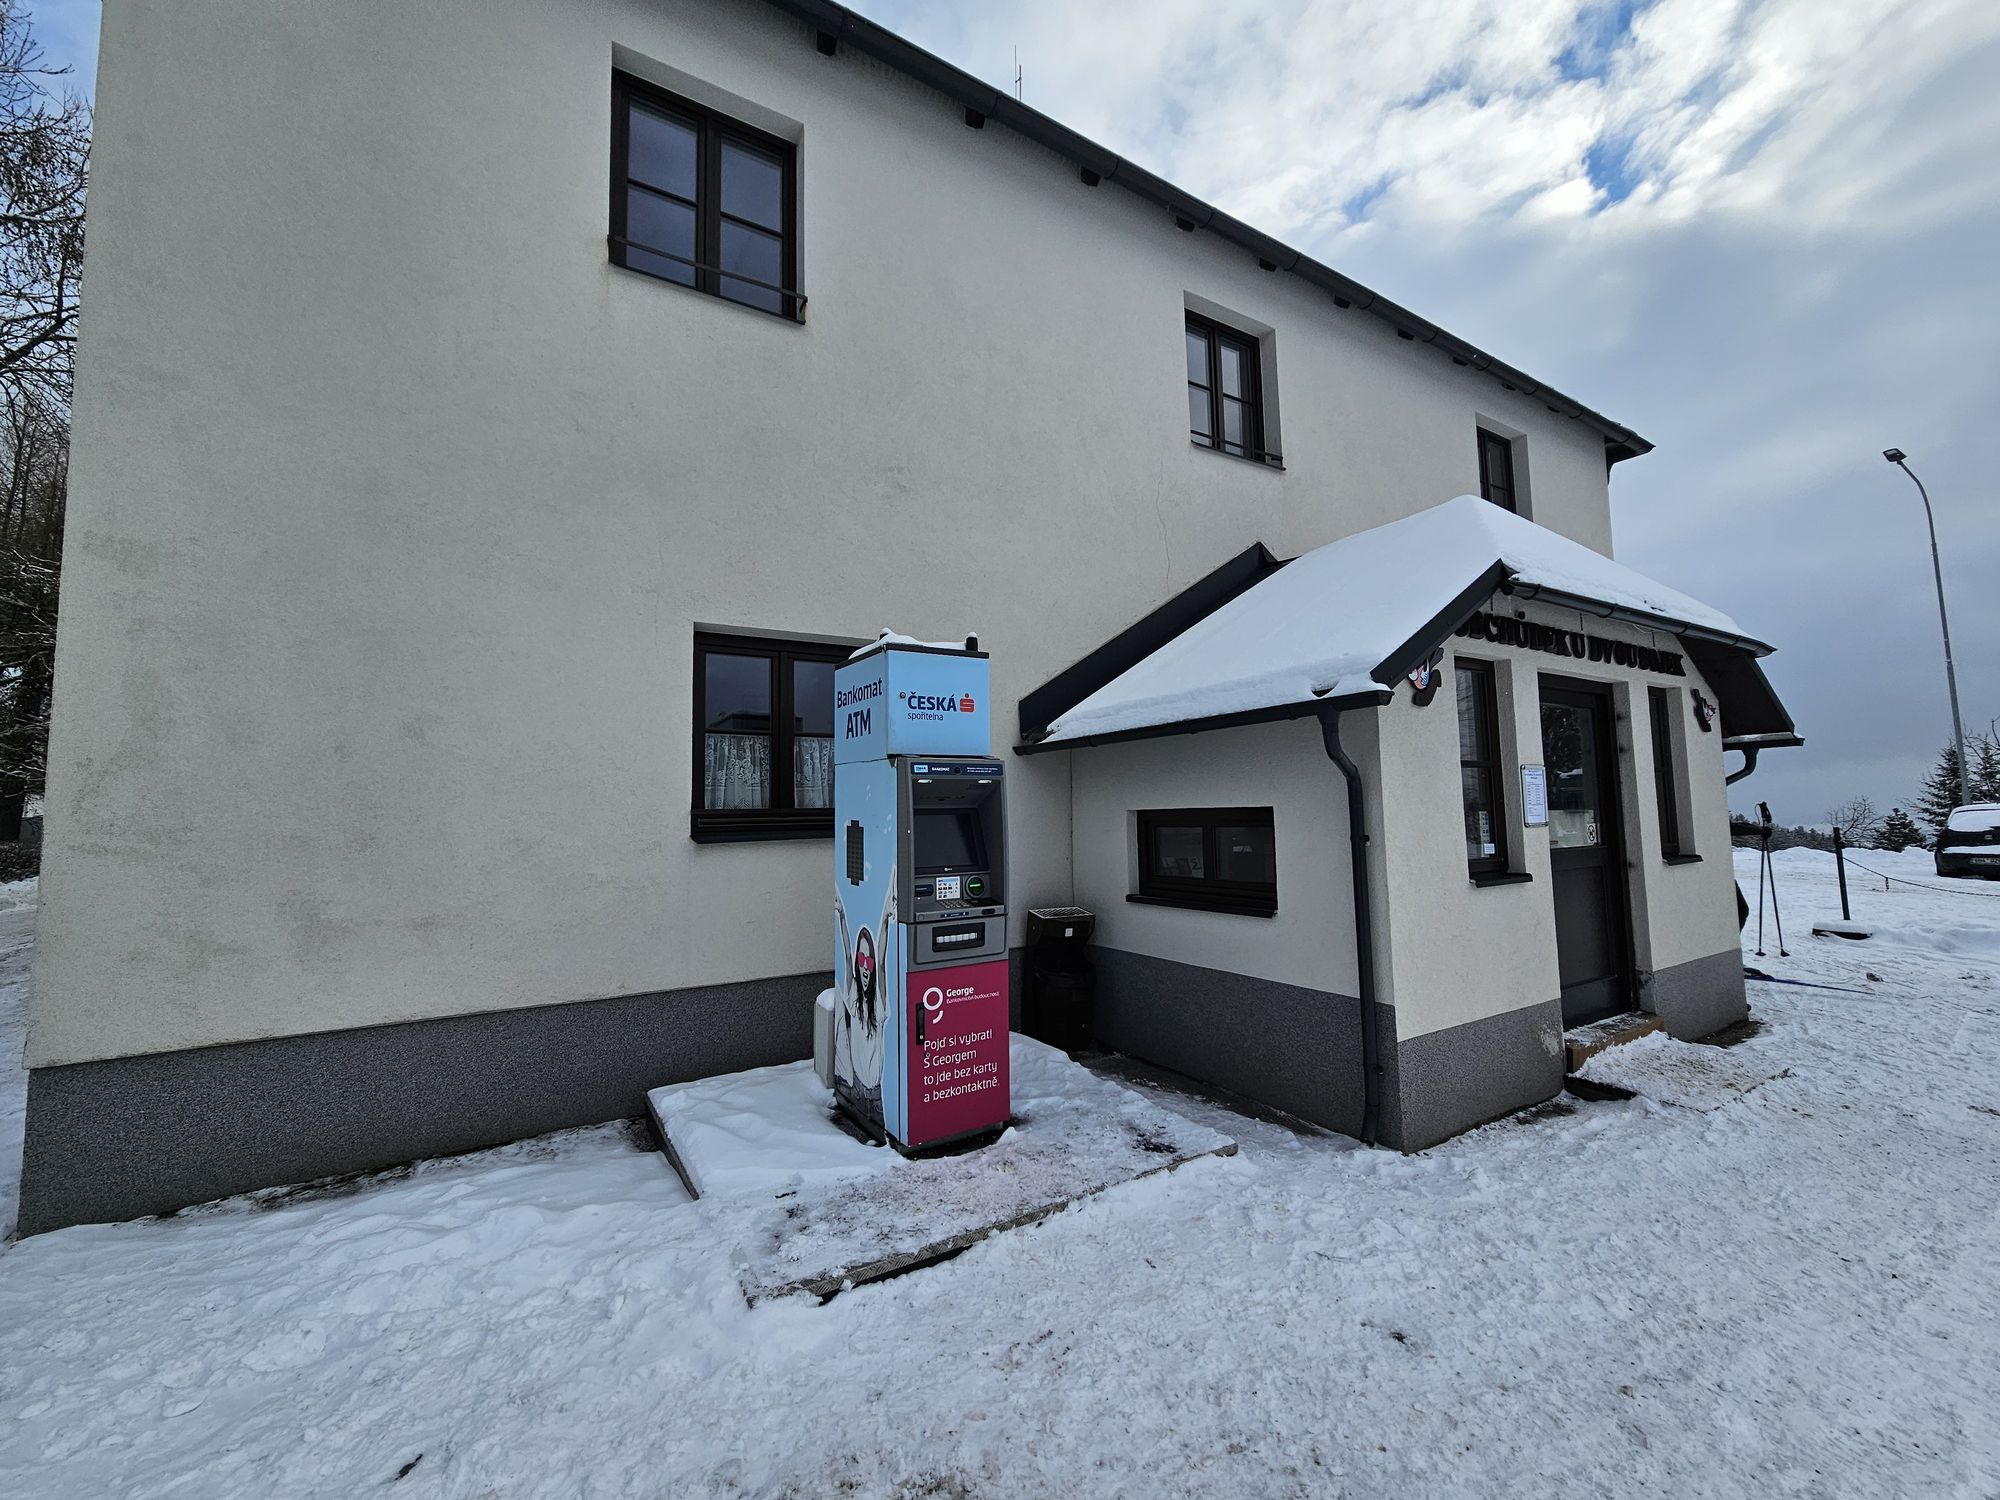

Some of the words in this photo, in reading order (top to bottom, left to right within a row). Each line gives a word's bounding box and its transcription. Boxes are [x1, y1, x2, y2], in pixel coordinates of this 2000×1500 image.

[837, 677, 883, 708] Bankomat
[908, 691, 957, 712] ČESKÁ
[846, 708, 872, 739] ATM
[907, 711, 944, 721] spořitelna
[946, 986, 974, 997] George
[924, 1036, 947, 1051] Pojď
[948, 1034, 957, 1047] si
[932, 1049, 977, 1066] Georgem
[923, 1075, 934, 1086] to
[935, 1070, 952, 1086] jde
[954, 1066, 972, 1079] bez
[973, 1061, 998, 1077] karty
[923, 1093, 931, 1103] a
